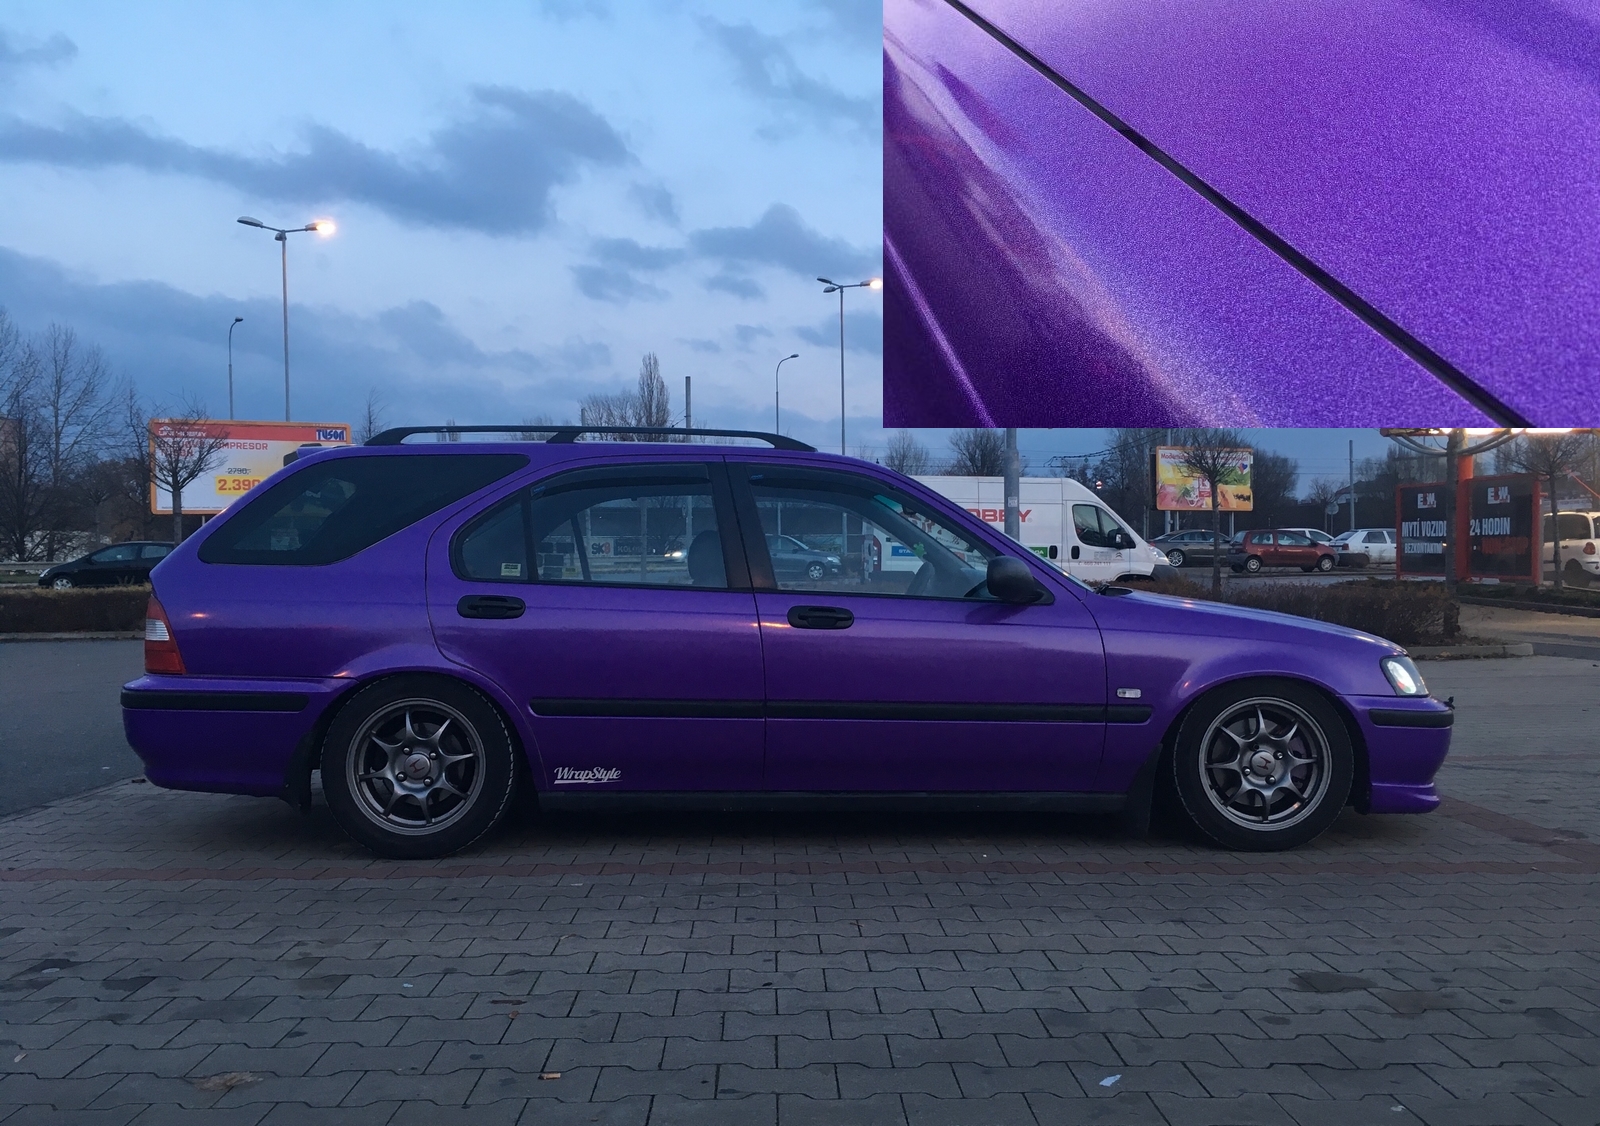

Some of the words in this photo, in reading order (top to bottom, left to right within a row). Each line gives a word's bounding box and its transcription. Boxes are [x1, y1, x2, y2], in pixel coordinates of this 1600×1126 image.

[1402, 518, 1420, 537] MYTÍ
[1470, 519, 1480, 536] 24
[1482, 517, 1510, 535] HODIN
[553, 766, 622, 783] WrapStyle
